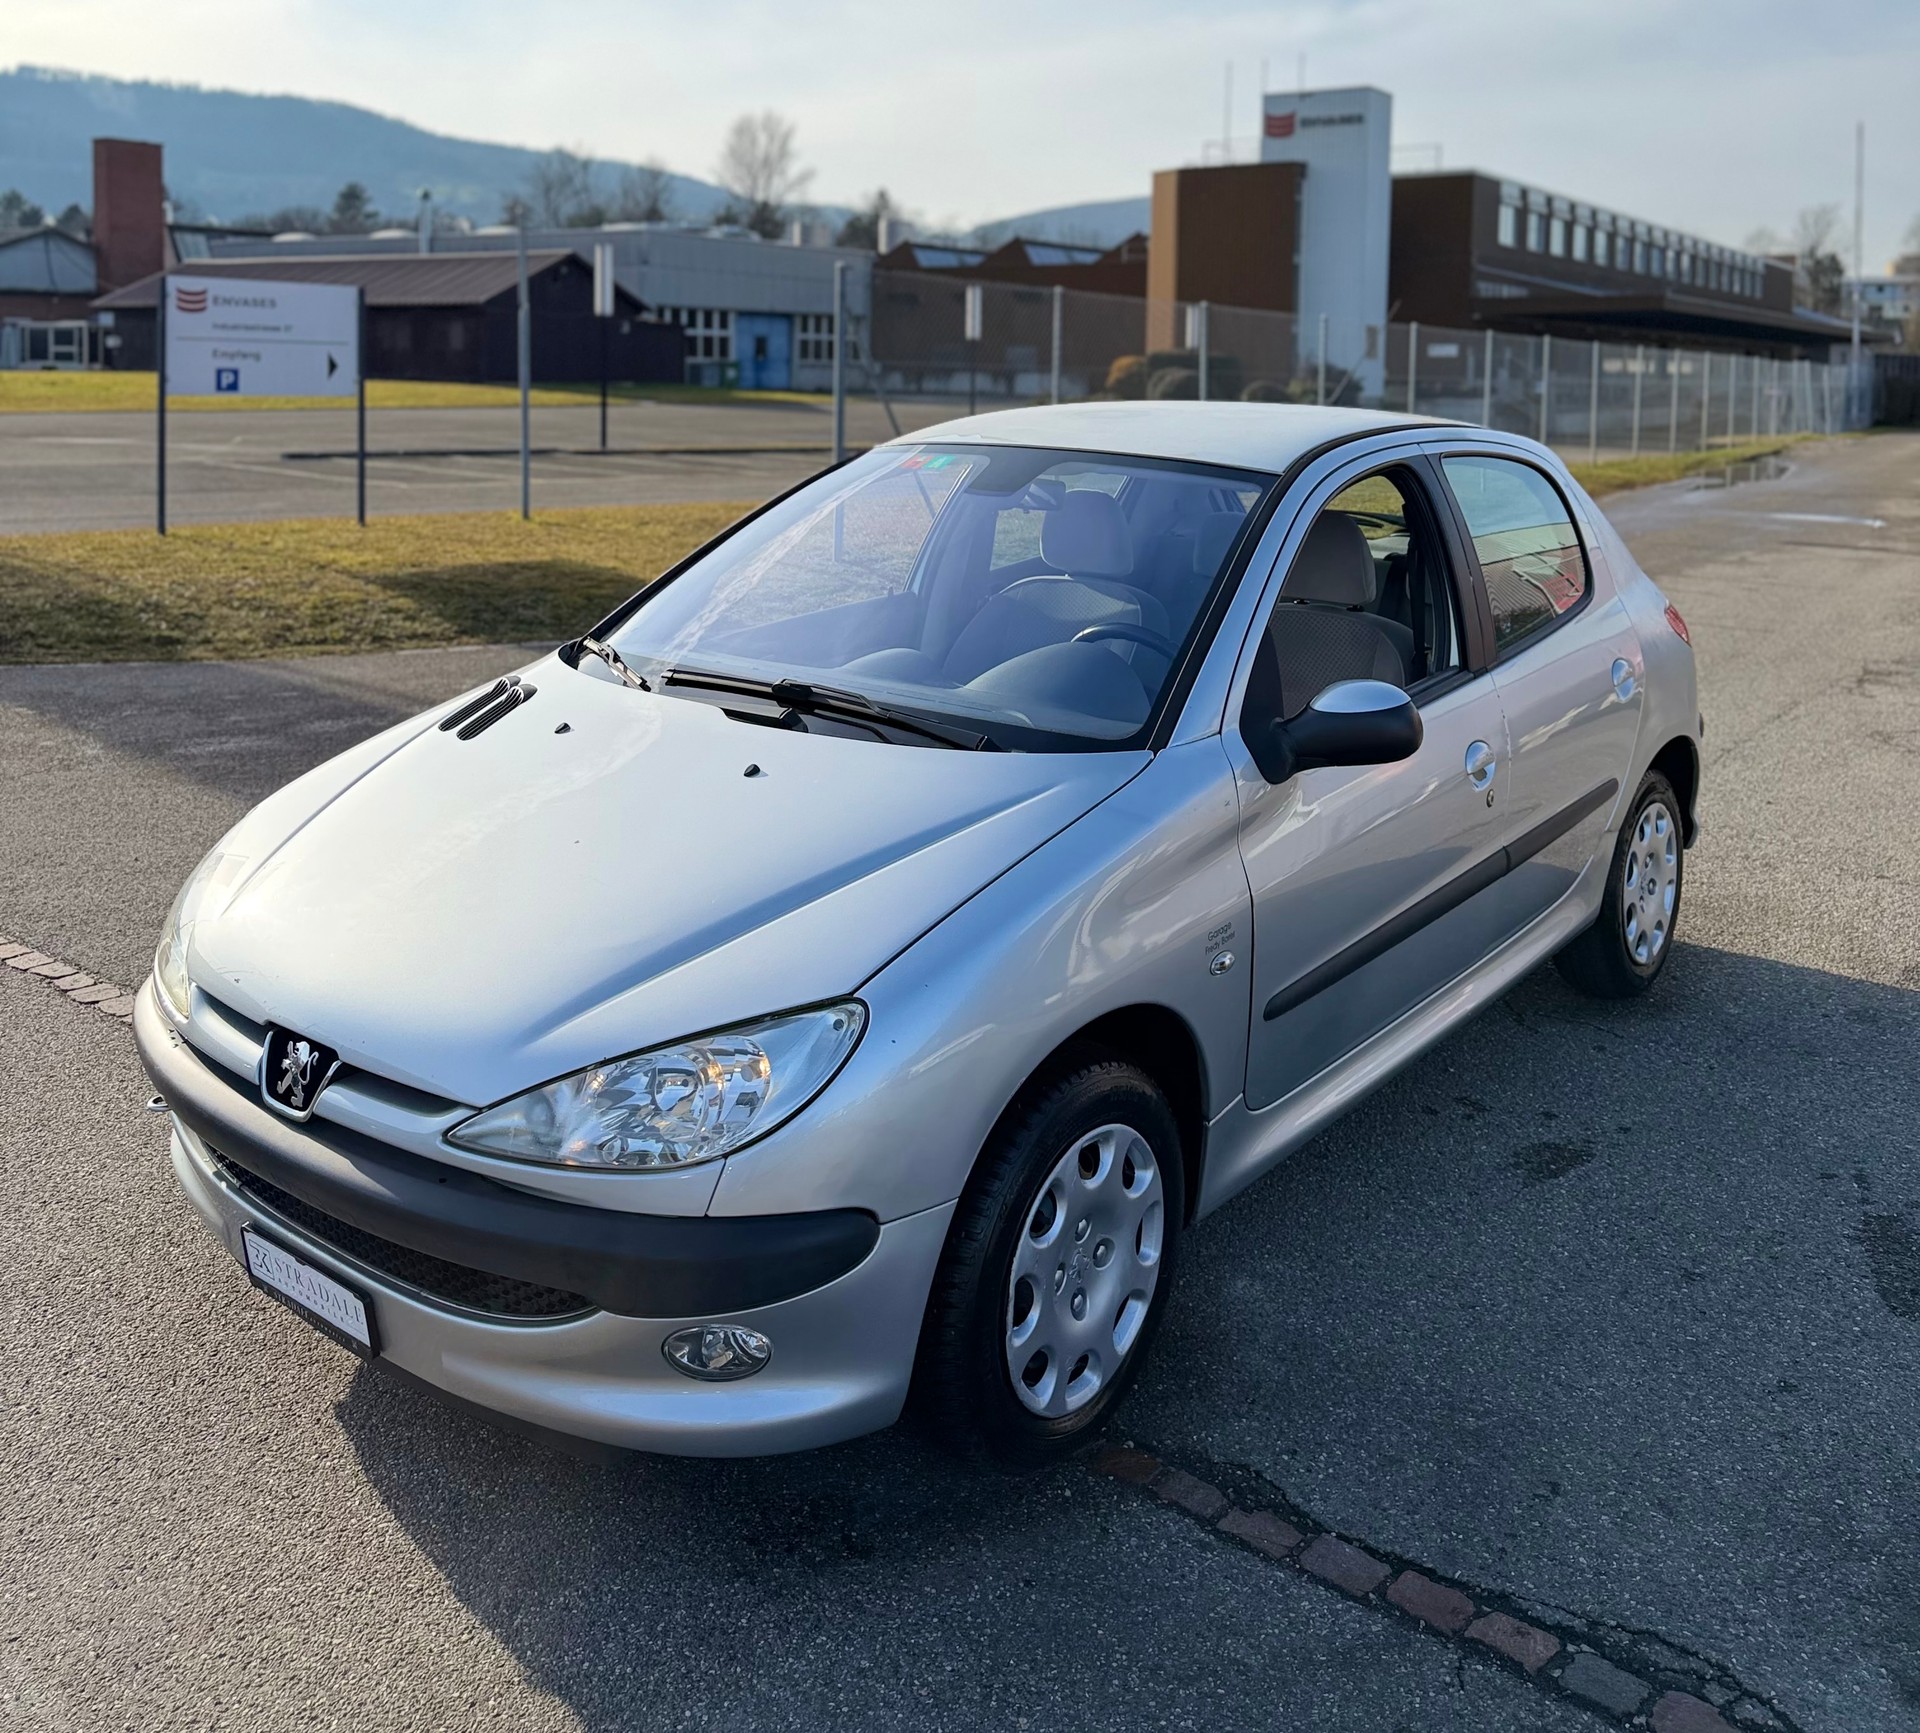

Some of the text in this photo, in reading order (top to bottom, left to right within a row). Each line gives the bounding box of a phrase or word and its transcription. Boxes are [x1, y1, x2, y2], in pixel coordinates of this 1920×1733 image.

[212, 295, 277, 309] ENVASES
[212, 349, 261, 362] Empfang
[1208, 921, 1232, 942] Garage
[274, 1257, 365, 1326] STRADALE
